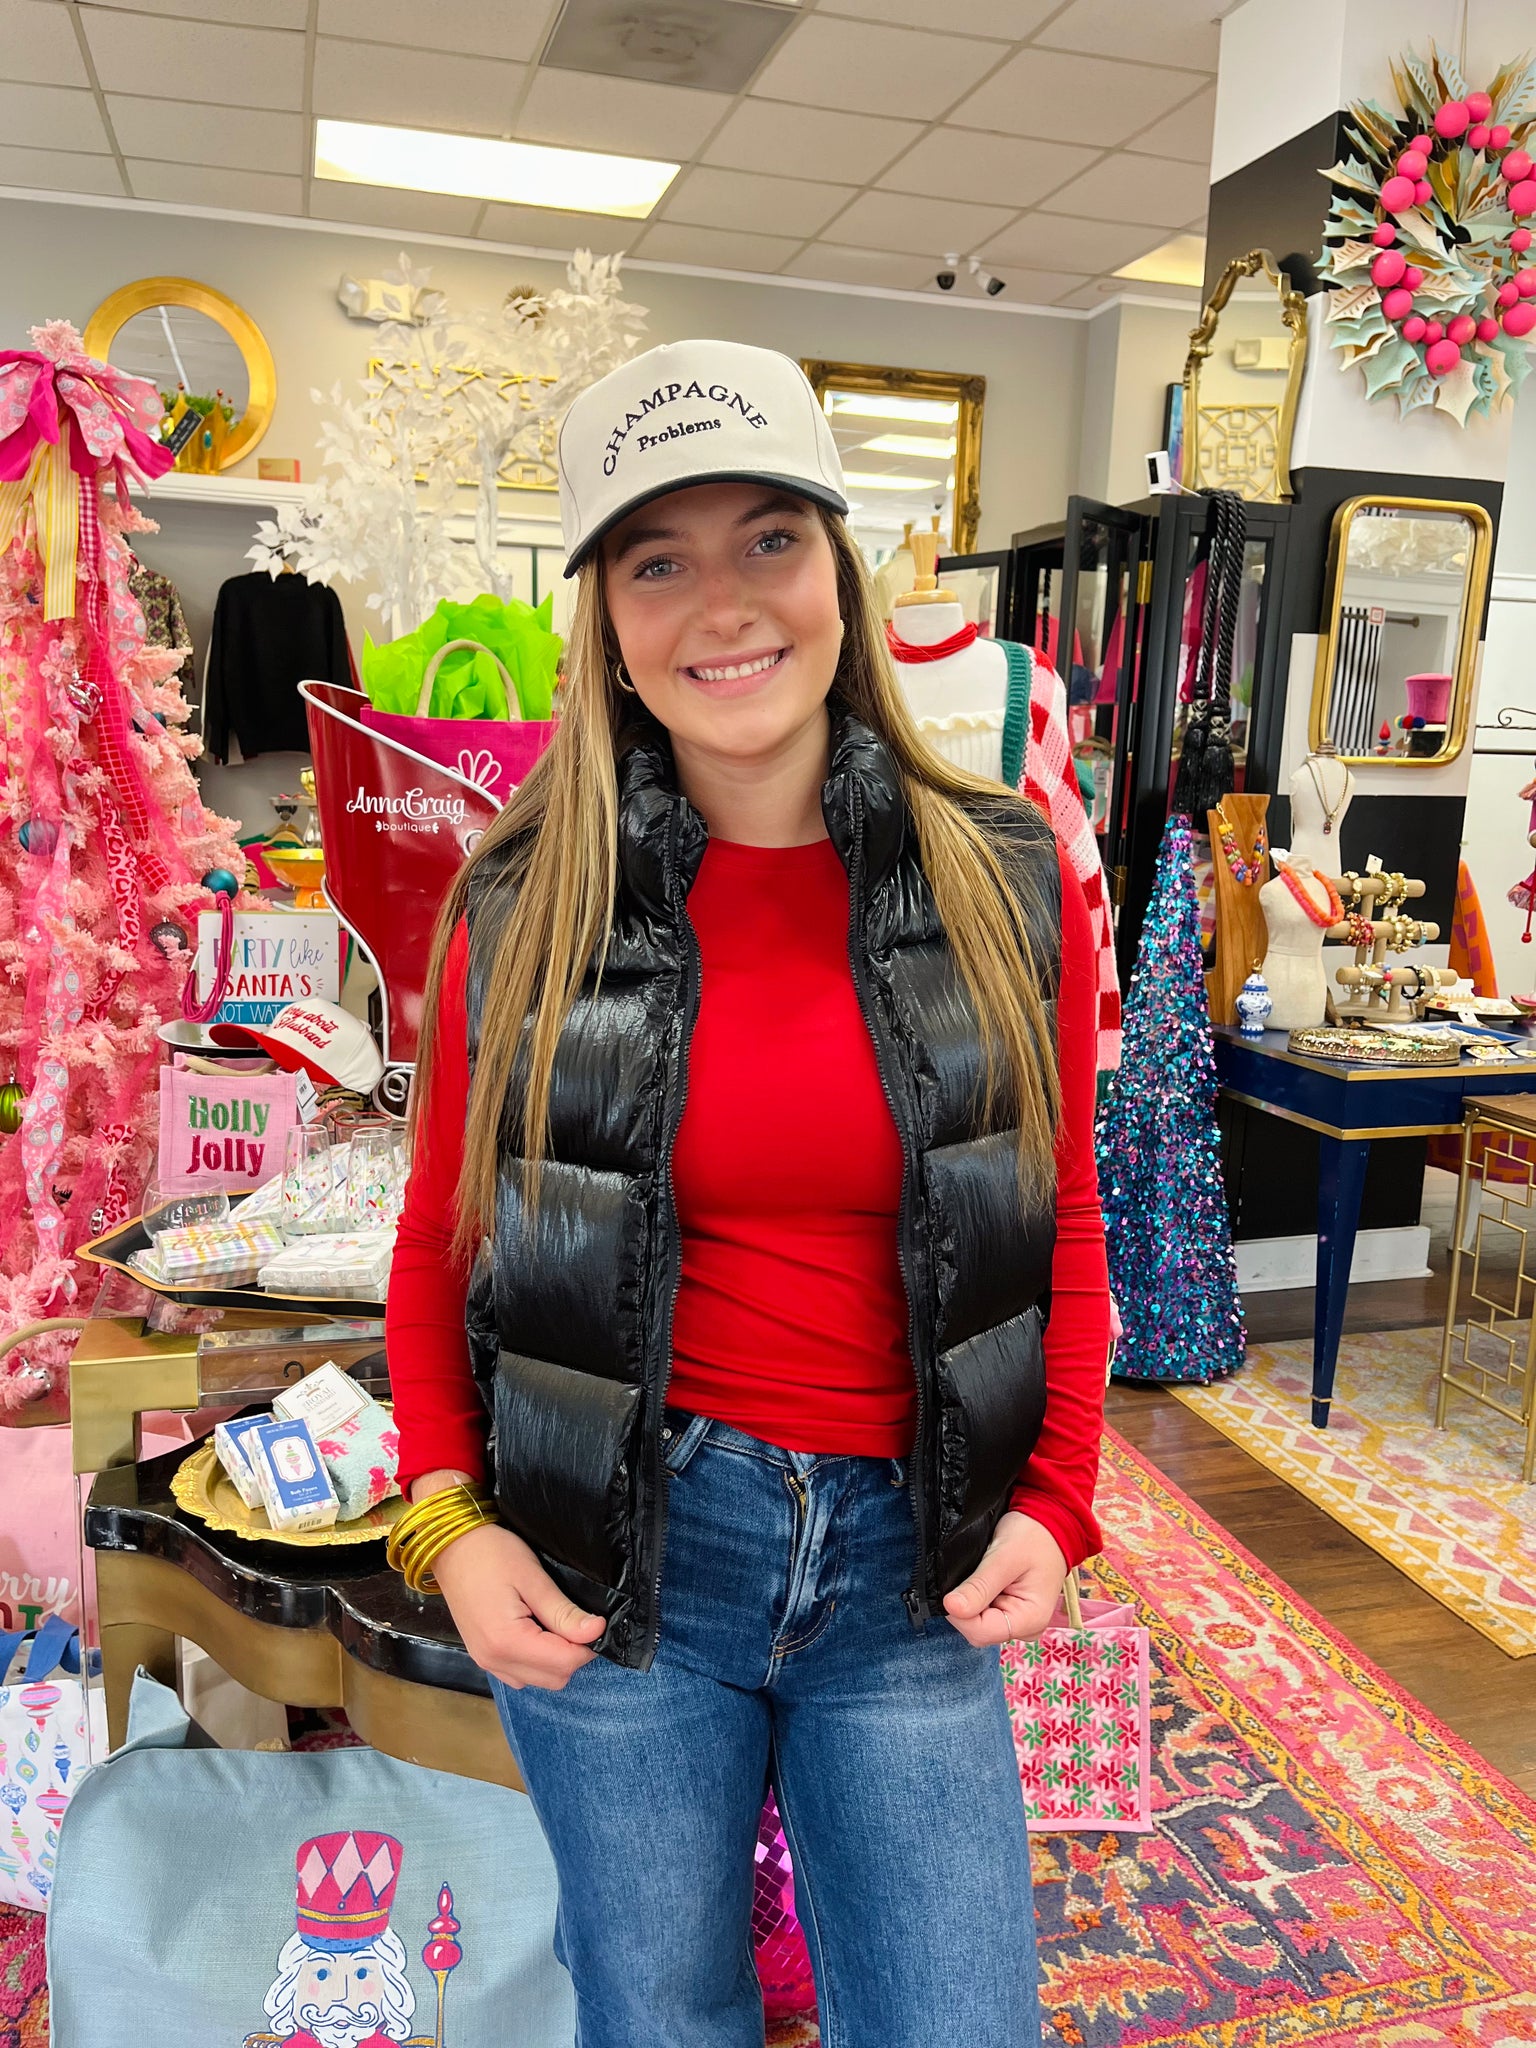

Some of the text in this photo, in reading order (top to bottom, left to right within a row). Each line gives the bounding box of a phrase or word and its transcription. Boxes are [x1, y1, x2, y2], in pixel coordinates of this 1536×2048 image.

[603, 381, 768, 477] CHAMPAGNE
[637, 418, 722, 452] Problems
[346, 786, 470, 824] AnnaCraig
[382, 821, 432, 833] boutique
[290, 938, 325, 968] like
[223, 973, 312, 997] SANTA'S
[213, 1003, 286, 1023] NOT WAT
[302, 1012, 339, 1034] about
[273, 1017, 332, 1049] Husband
[187, 1094, 271, 1137] Holly
[185, 1135, 266, 1177] Jolly
